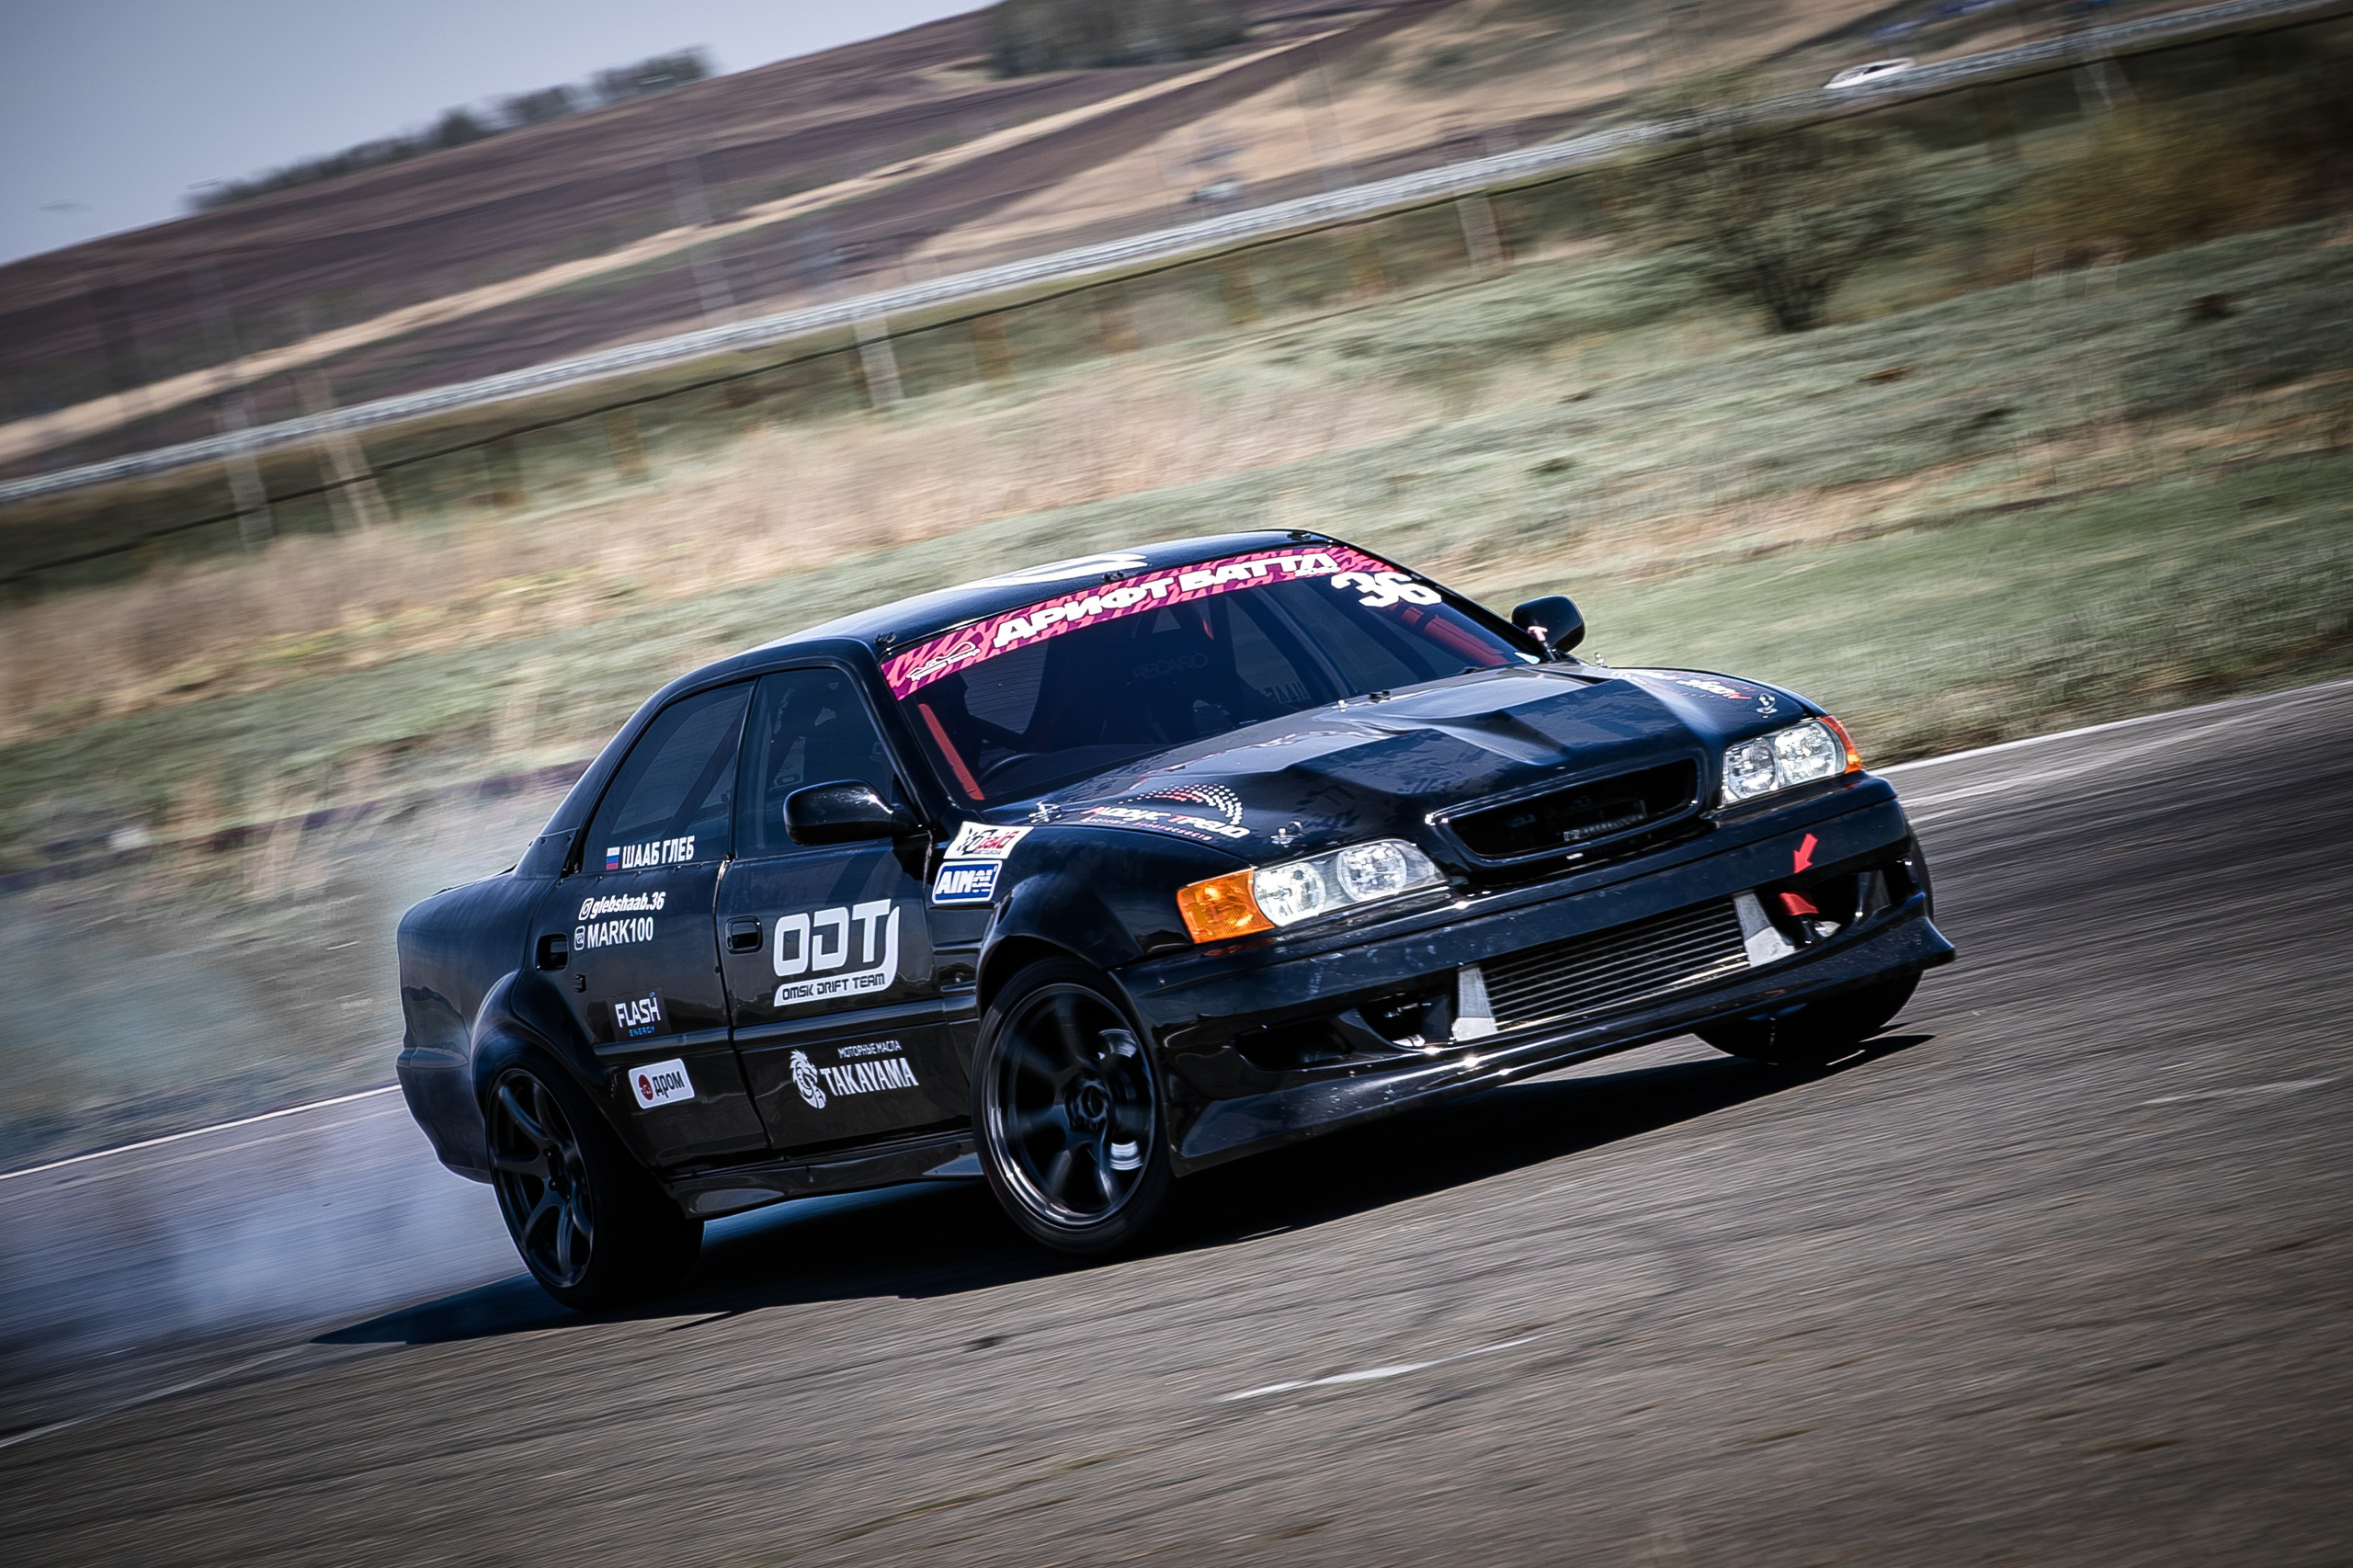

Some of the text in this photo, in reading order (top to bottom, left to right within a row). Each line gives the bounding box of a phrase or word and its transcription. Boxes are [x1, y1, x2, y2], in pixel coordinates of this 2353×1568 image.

[1331, 572, 1442, 608] 36
[993, 577, 1175, 648] ДРИФТ
[621, 835, 695, 869] ШААБ ГЛЕБ
[587, 917, 654, 949] MARK100
[774, 899, 892, 976] ODT
[782, 972, 885, 1000] OMSK DRIFT TEAM
[615, 997, 661, 1028] FLASH
[629, 1026, 655, 1037] ENERGY
[876, 1040, 903, 1053] МАСЛА
[819, 1057, 919, 1096] TAKAYAMA
